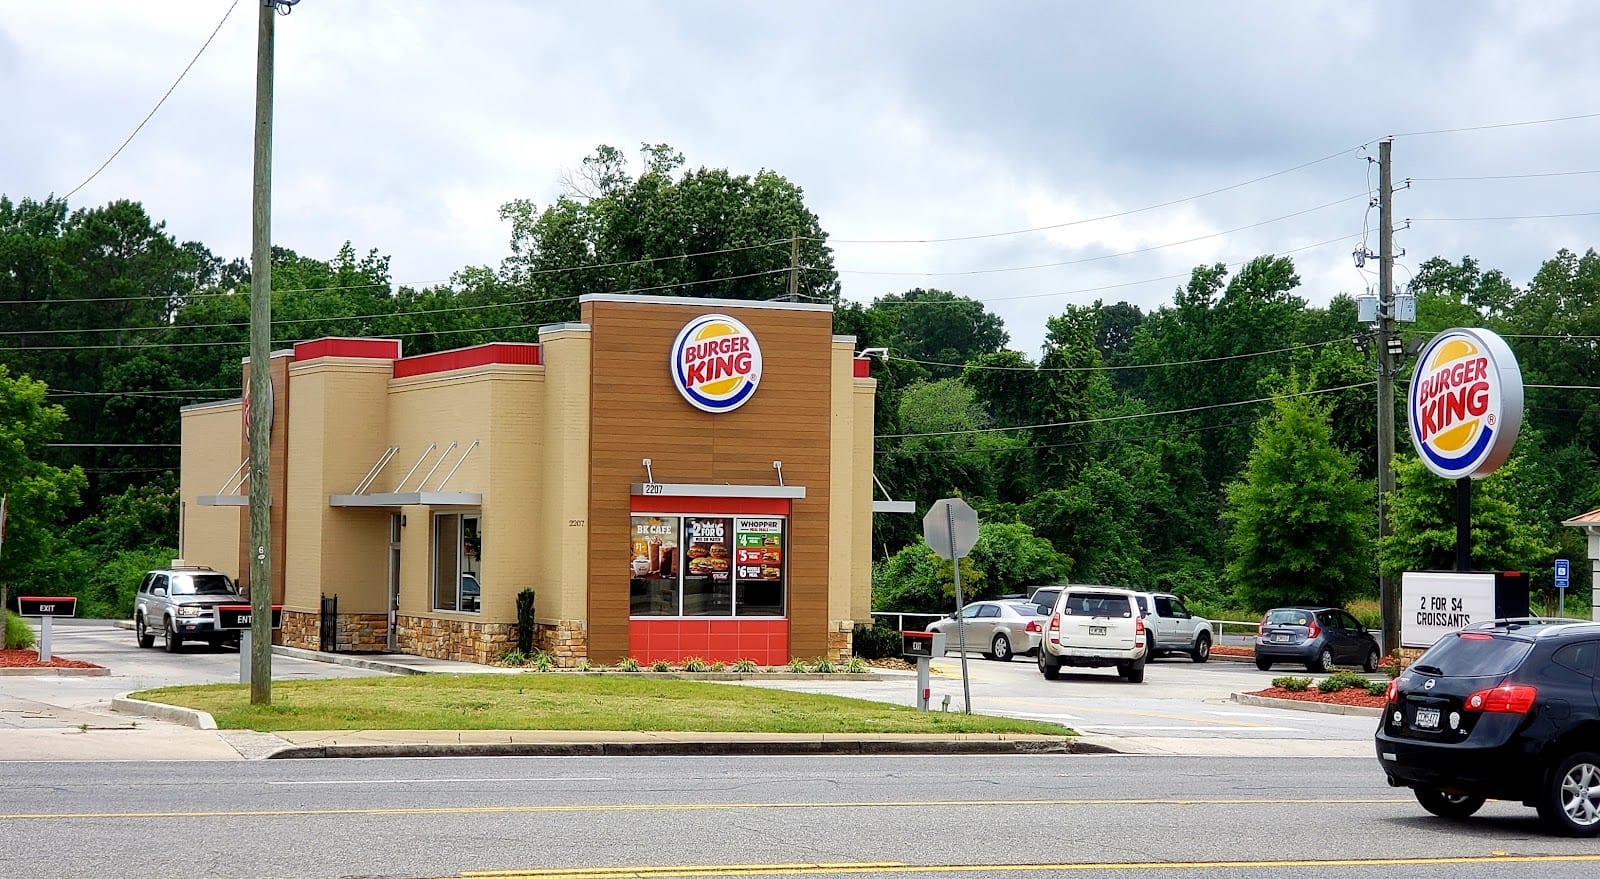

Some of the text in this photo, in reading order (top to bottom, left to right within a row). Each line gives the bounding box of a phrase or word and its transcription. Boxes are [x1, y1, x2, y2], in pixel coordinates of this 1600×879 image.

[685, 336, 750, 364] BURGER
[687, 352, 752, 387] KING
[1420, 357, 1488, 406] BURGER
[1421, 381, 1490, 441] KING
[645, 484, 663, 494] 2207
[568, 519, 585, 527] 2207
[637, 525, 650, 535] BK
[701, 528, 715, 537] FOR
[39, 604, 56, 612] EXIT
[1420, 596, 1427, 610] 2
[1430, 596, 1447, 612] FOR
[1416, 611, 1470, 628] CROISSANTS
